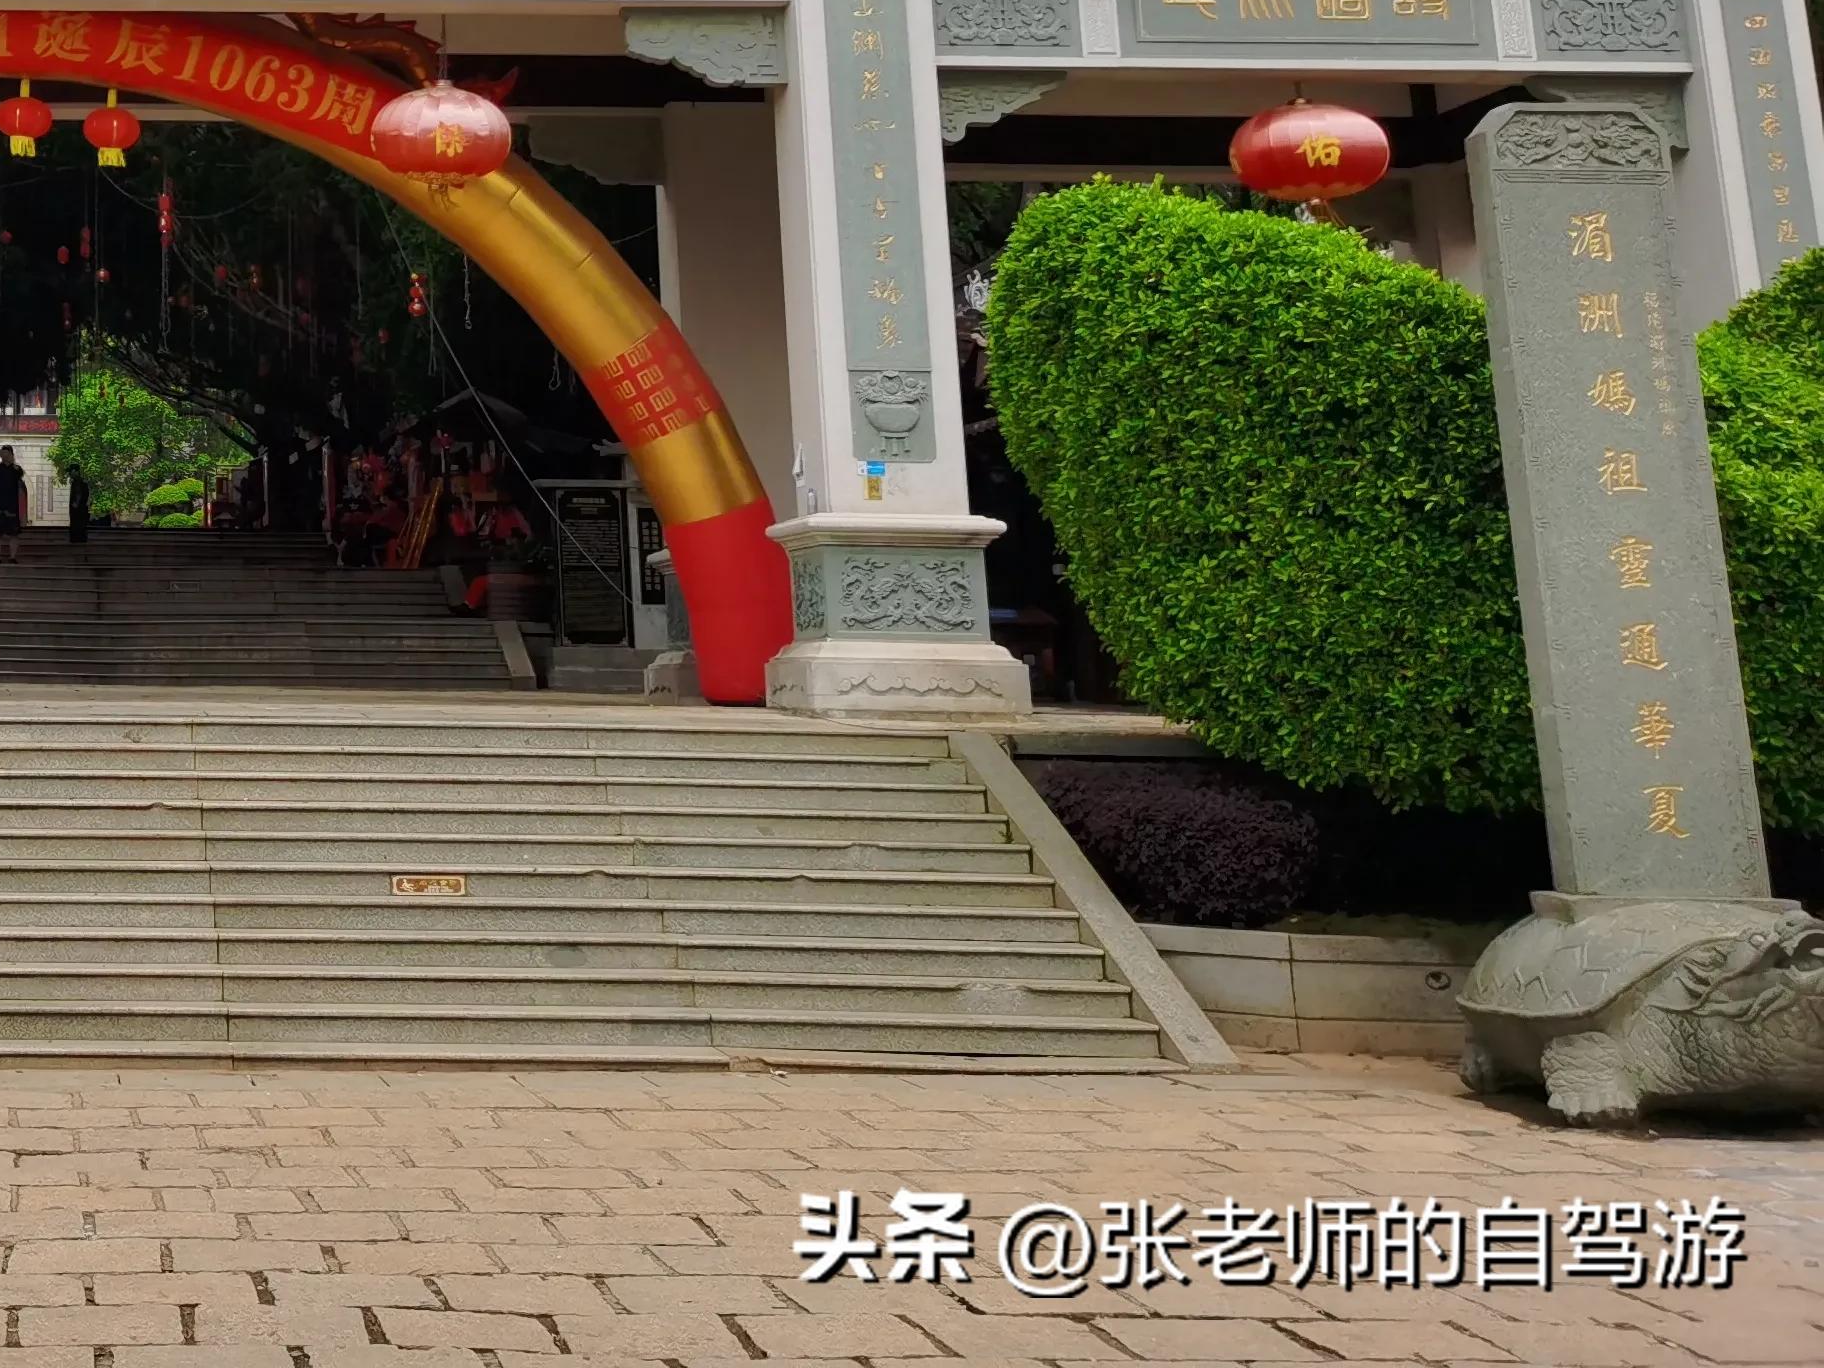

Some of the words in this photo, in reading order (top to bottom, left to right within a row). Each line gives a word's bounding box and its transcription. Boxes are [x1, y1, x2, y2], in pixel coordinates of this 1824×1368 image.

[1567, 208, 1691, 840] 湄洲媽祖靈通華夏
